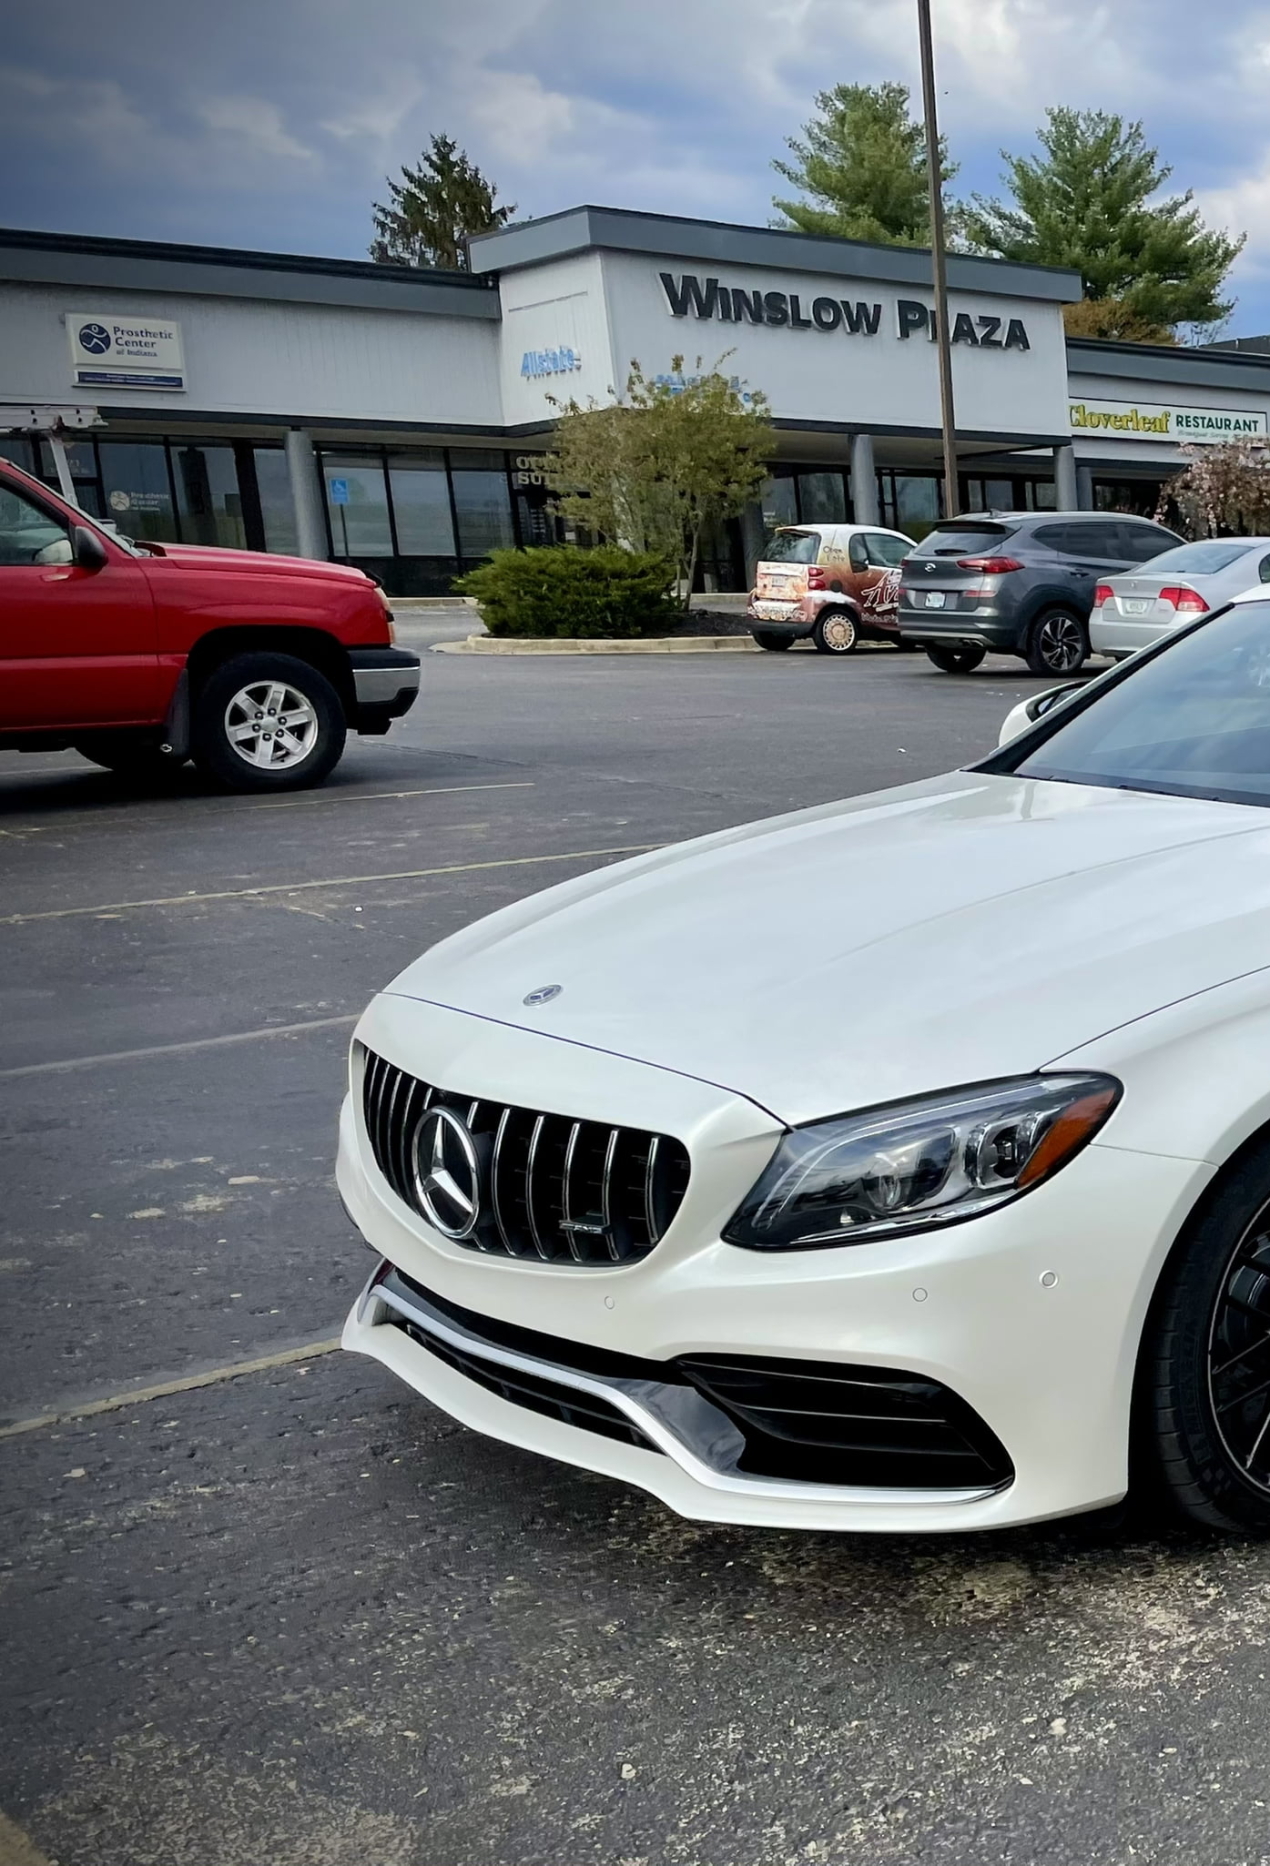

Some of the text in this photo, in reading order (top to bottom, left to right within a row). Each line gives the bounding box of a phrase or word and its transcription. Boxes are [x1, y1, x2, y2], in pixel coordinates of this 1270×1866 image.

[659, 272, 882, 335] WINSLOW
[113, 326, 174, 340] Prosthetic
[115, 337, 156, 349] Center
[520, 346, 575, 378] Allstate
[1069, 404, 1259, 433] Cloverleaf RESTAURANT
